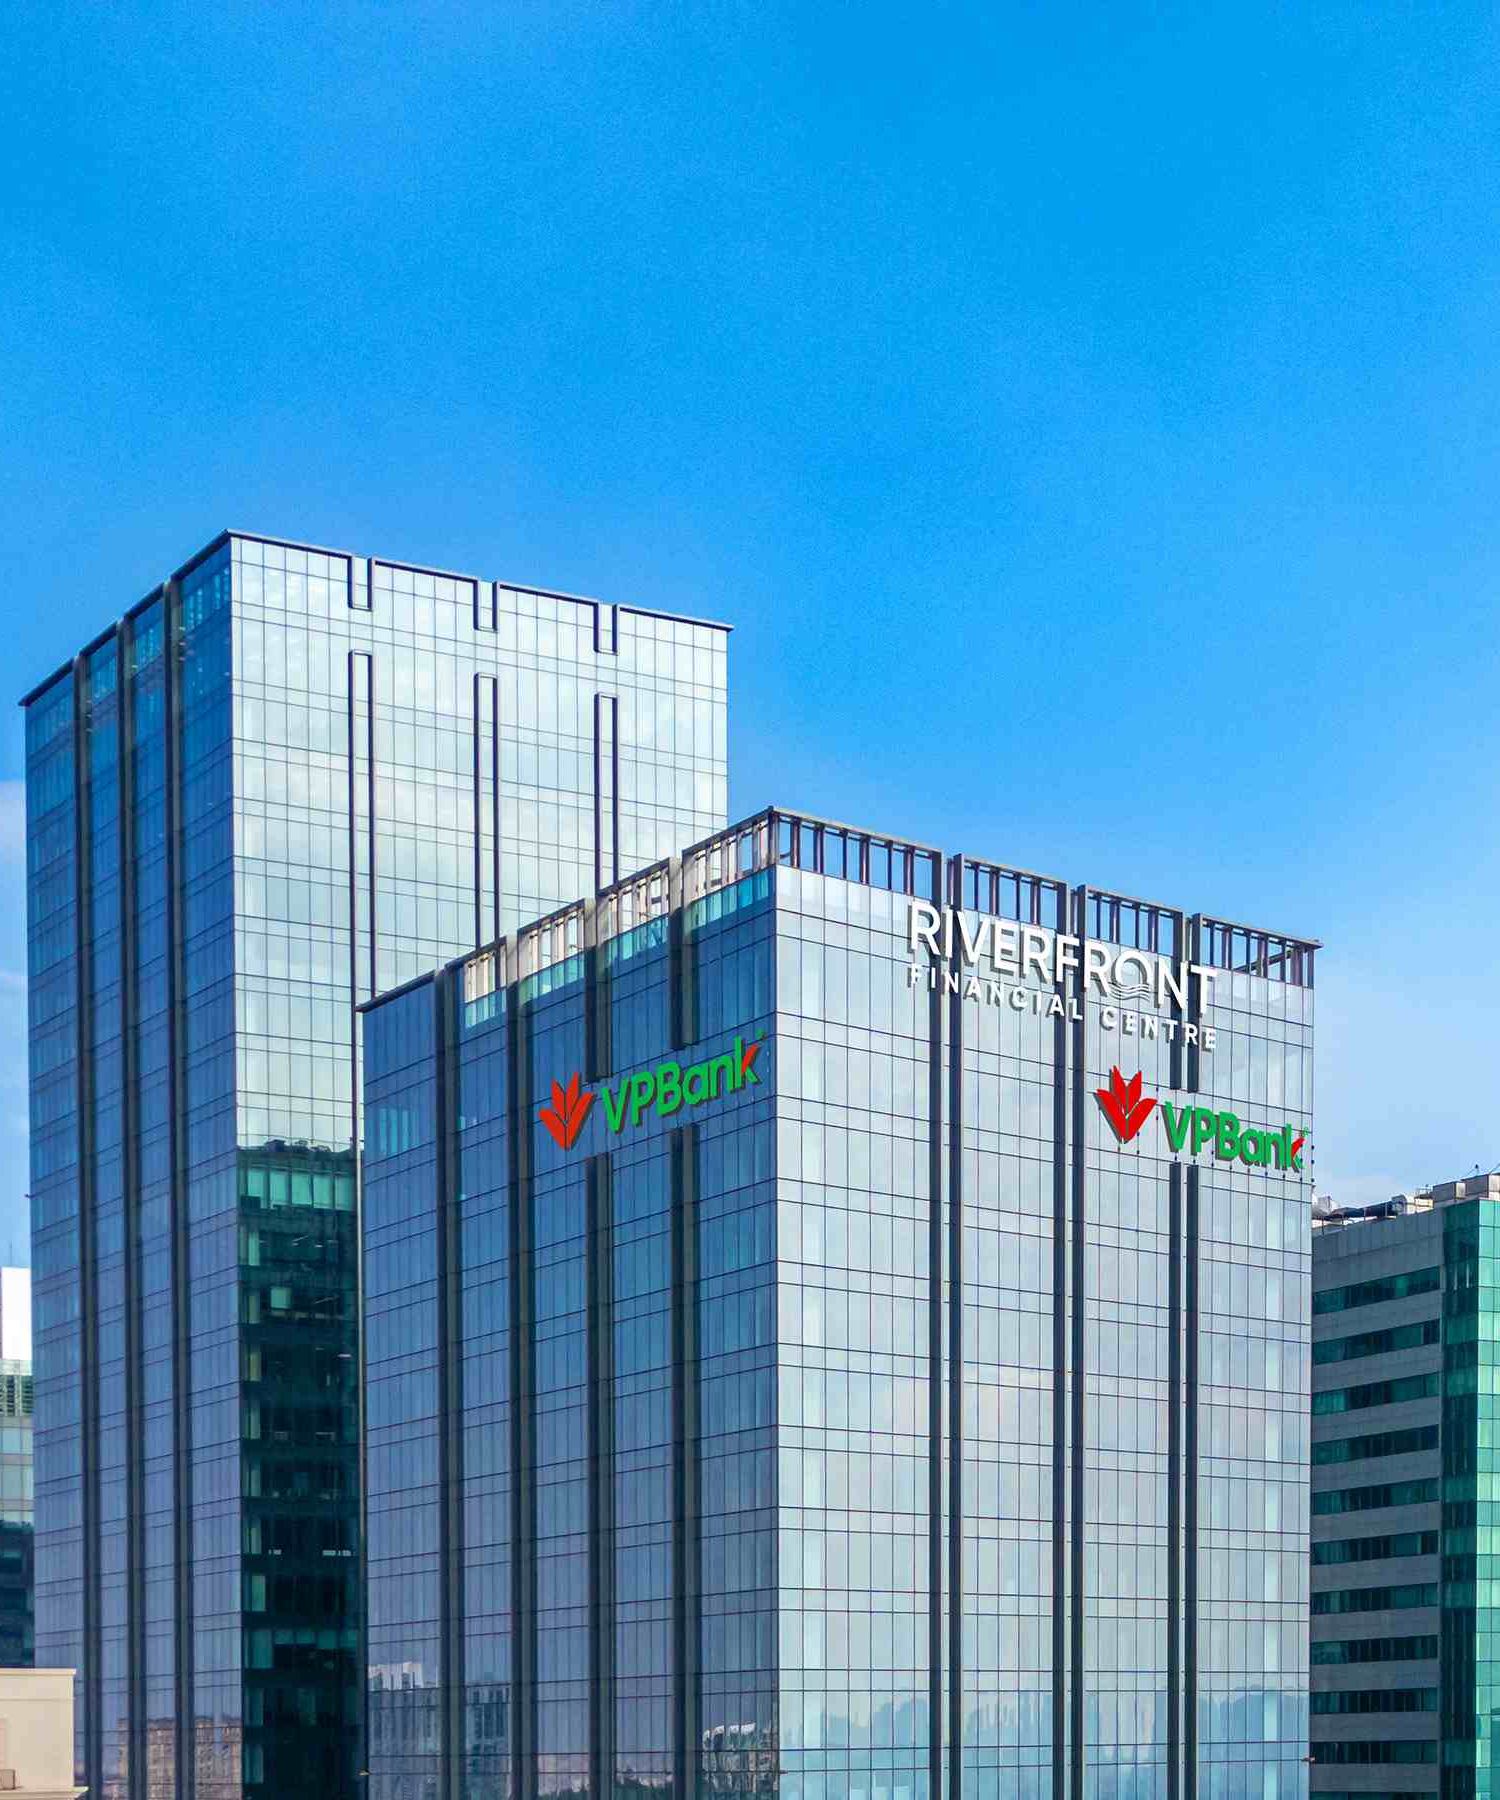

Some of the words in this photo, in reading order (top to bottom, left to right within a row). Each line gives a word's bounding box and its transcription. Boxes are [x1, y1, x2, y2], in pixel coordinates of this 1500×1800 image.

[910, 899, 1217, 1015] RIVERFRONT
[910, 962, 1083, 1021] FINANCIAL
[1101, 1006, 1217, 1050] CENTRE
[602, 1034, 760, 1134] VPBank
[1164, 1101, 1306, 1169] VPBank
